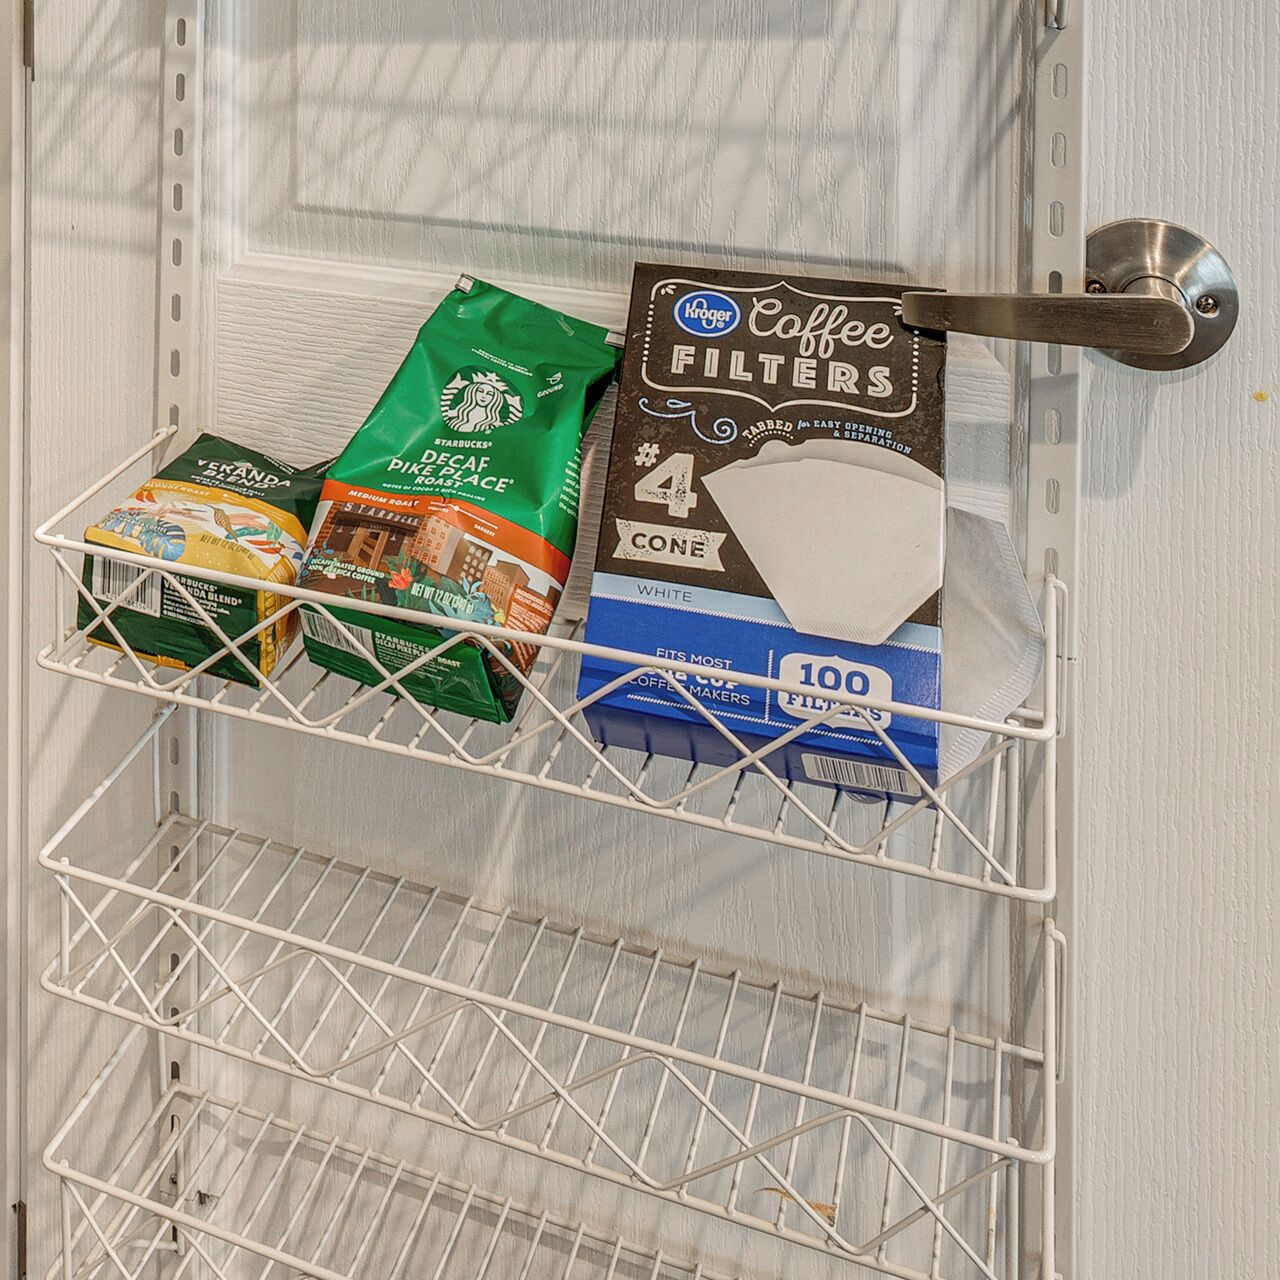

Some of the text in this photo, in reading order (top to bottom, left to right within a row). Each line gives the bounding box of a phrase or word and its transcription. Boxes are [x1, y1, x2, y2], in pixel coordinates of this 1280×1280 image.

[684, 296, 895, 360] Kroger Coffee
[670, 343, 895, 399] FILTERS
[741, 419, 894, 441] TABBED for EASY OPENING
[434, 438, 489, 449] STARBUCKS
[832, 429, 913, 456] & SEPARATION
[420, 449, 491, 473] DECAF
[386, 458, 511, 493] PIKE PLACE
[414, 476, 464, 489] ROAST
[347, 489, 420, 508] MEDIUM ROAST
[630, 532, 706, 560] CONE
[351, 572, 377, 585] COFFEE
[356, 565, 386, 579] GROUND
[207, 591, 239, 606] BLEND
[410, 582, 425, 597] NET
[424, 586, 437, 601] WT
[436, 589, 444, 604] 12
[444, 592, 454, 607] OZ
[636, 583, 693, 603] WHITE
[655, 647, 733, 670] FITS MOST
[798, 663, 871, 696] 100
[689, 684, 751, 706] MAKERS
[786, 692, 882, 721] FILTS
